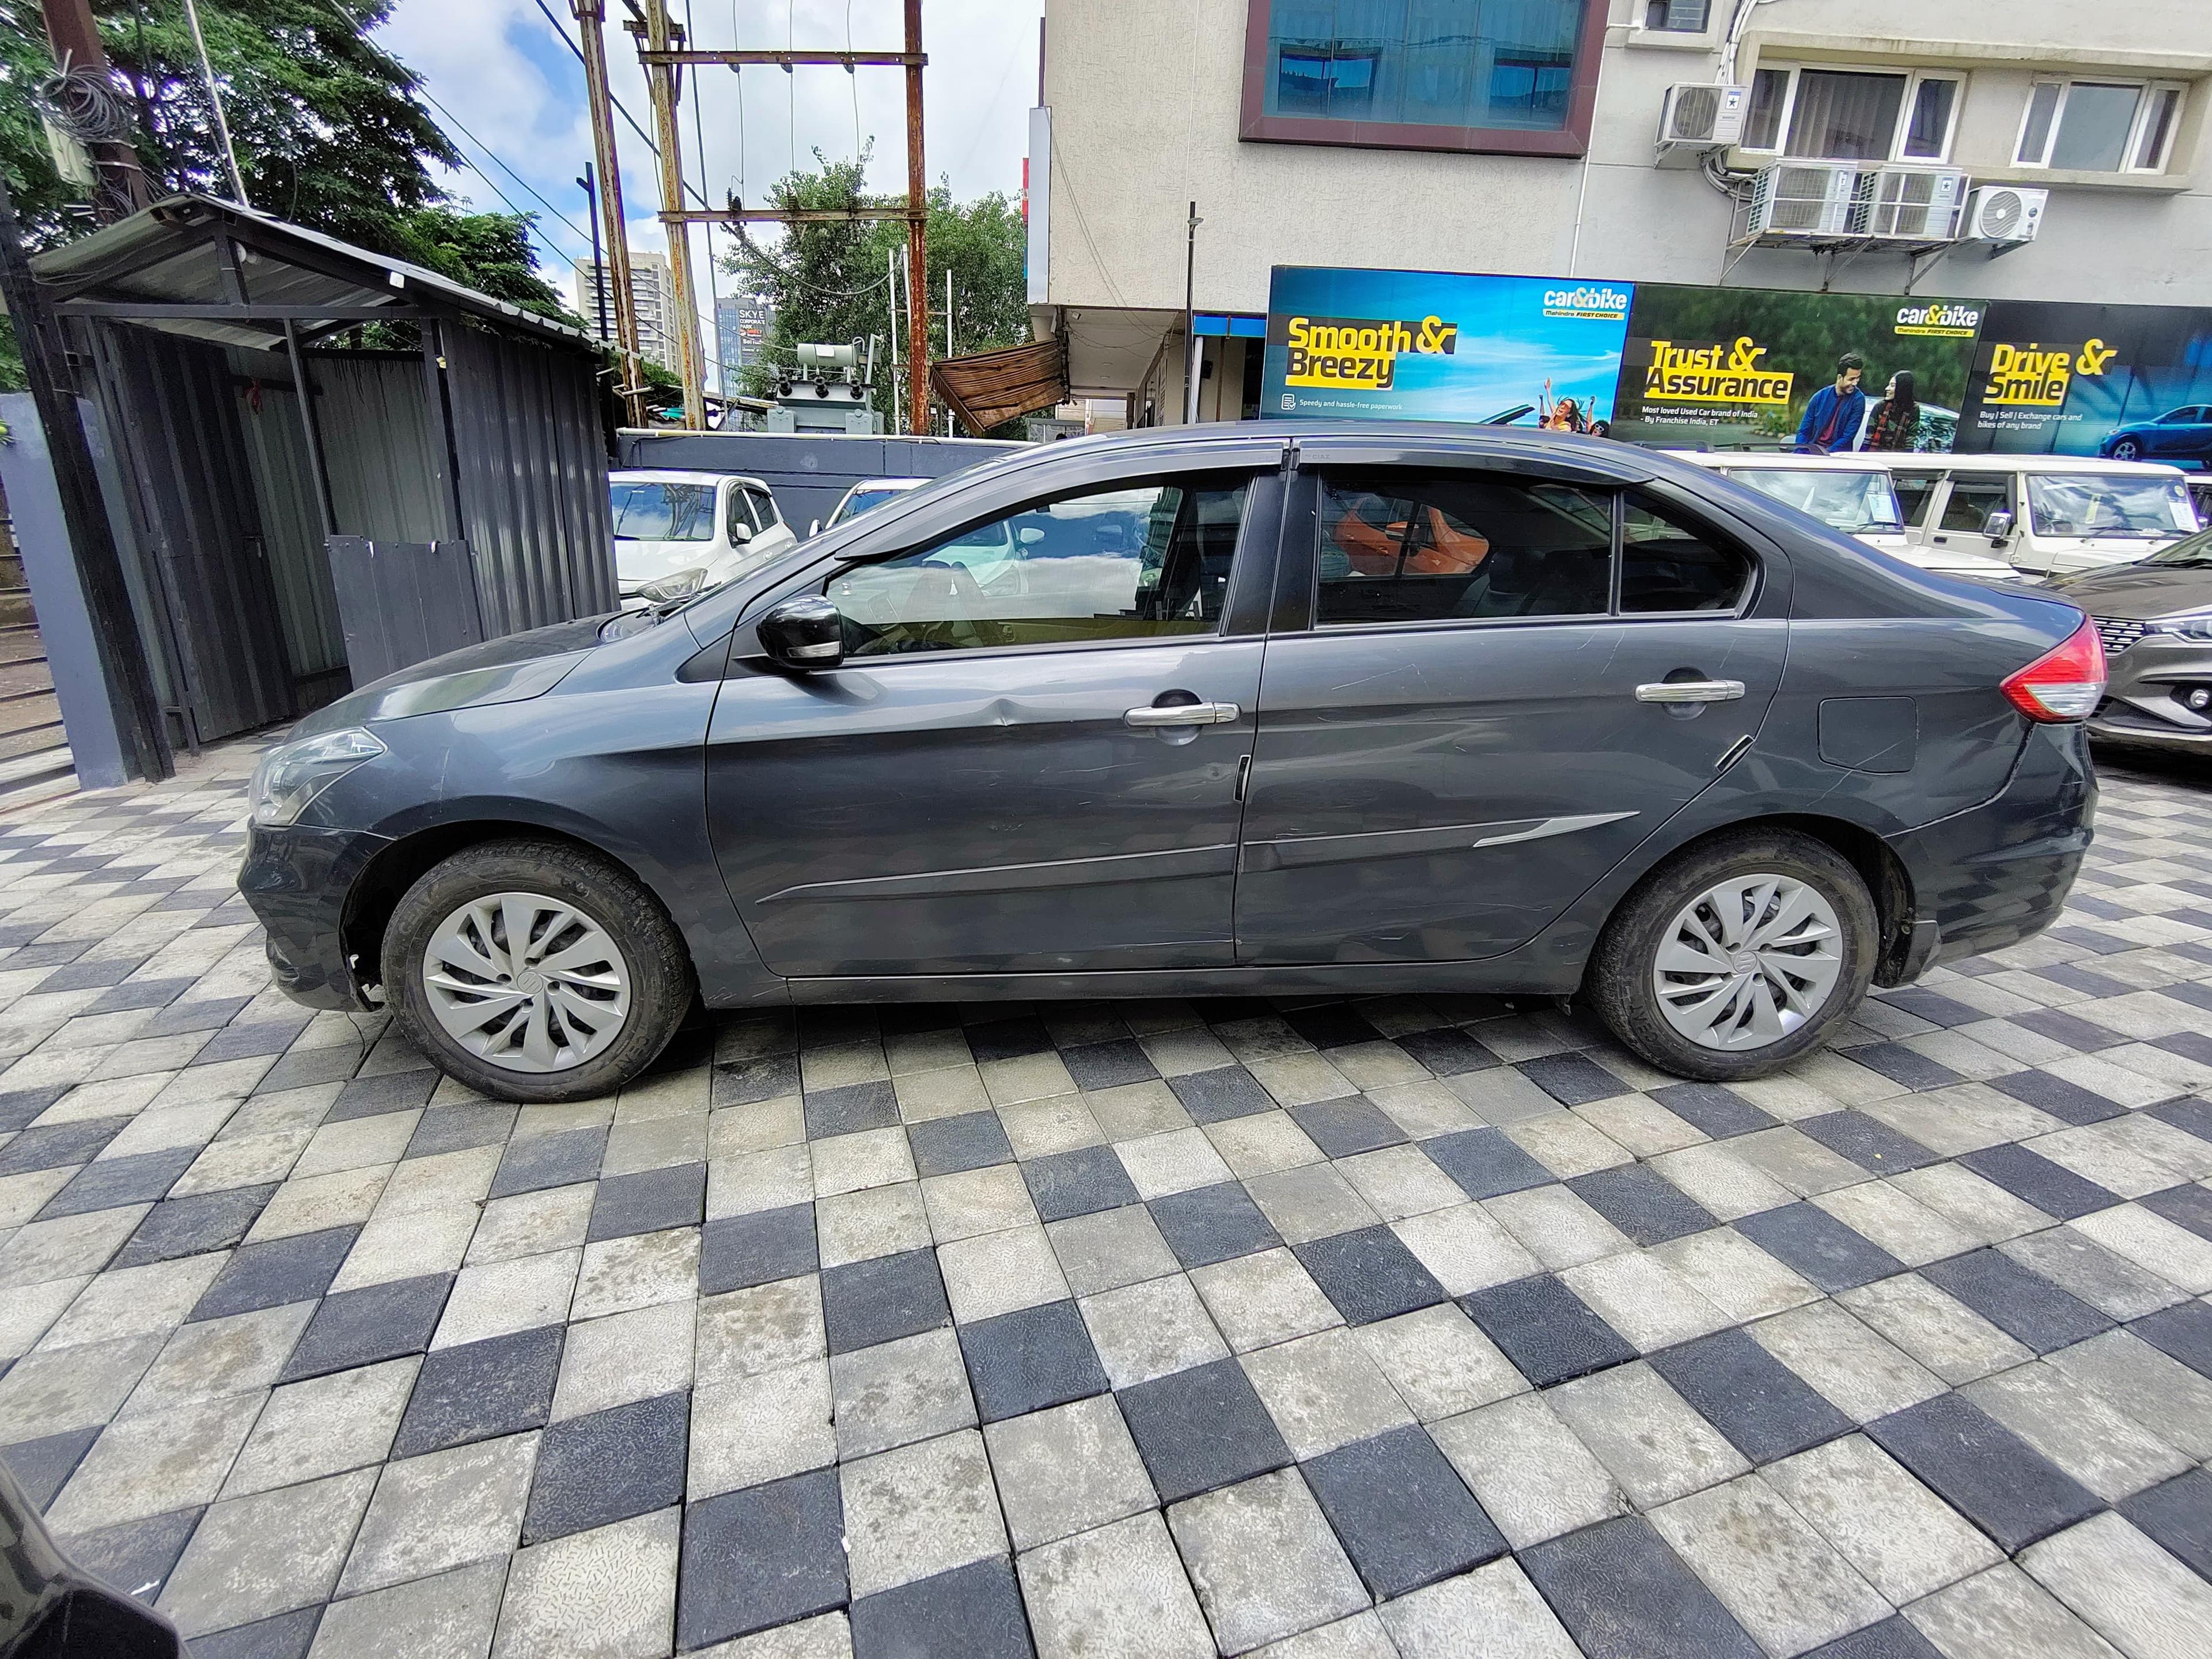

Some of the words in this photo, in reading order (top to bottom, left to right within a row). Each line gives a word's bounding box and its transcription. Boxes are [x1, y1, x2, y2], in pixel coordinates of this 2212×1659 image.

[1544, 287, 1627, 309] car&bike
[739, 309, 765, 319] SKYE
[1896, 305, 1979, 327] car&bike
[1289, 317, 1411, 353] Smooth
[1416, 316, 1457, 354] &
[1651, 340, 1724, 369] Trust
[1728, 336, 1767, 372] &
[1990, 343, 2070, 374] Drive
[2075, 338, 2118, 375] &
[1287, 347, 1395, 388] Breezy
[1645, 368, 1788, 399] Assurance
[1984, 372, 2063, 400] Smile
[1299, 399, 1322, 407] Speedy
[1336, 401, 1369, 409] hassle-free
[1980, 411, 1995, 419] Buy
[2018, 412, 2051, 421] Exchange
[1645, 416, 1654, 424] By
[1656, 416, 1688, 425] Franchise
[1689, 418, 1708, 426] India,
